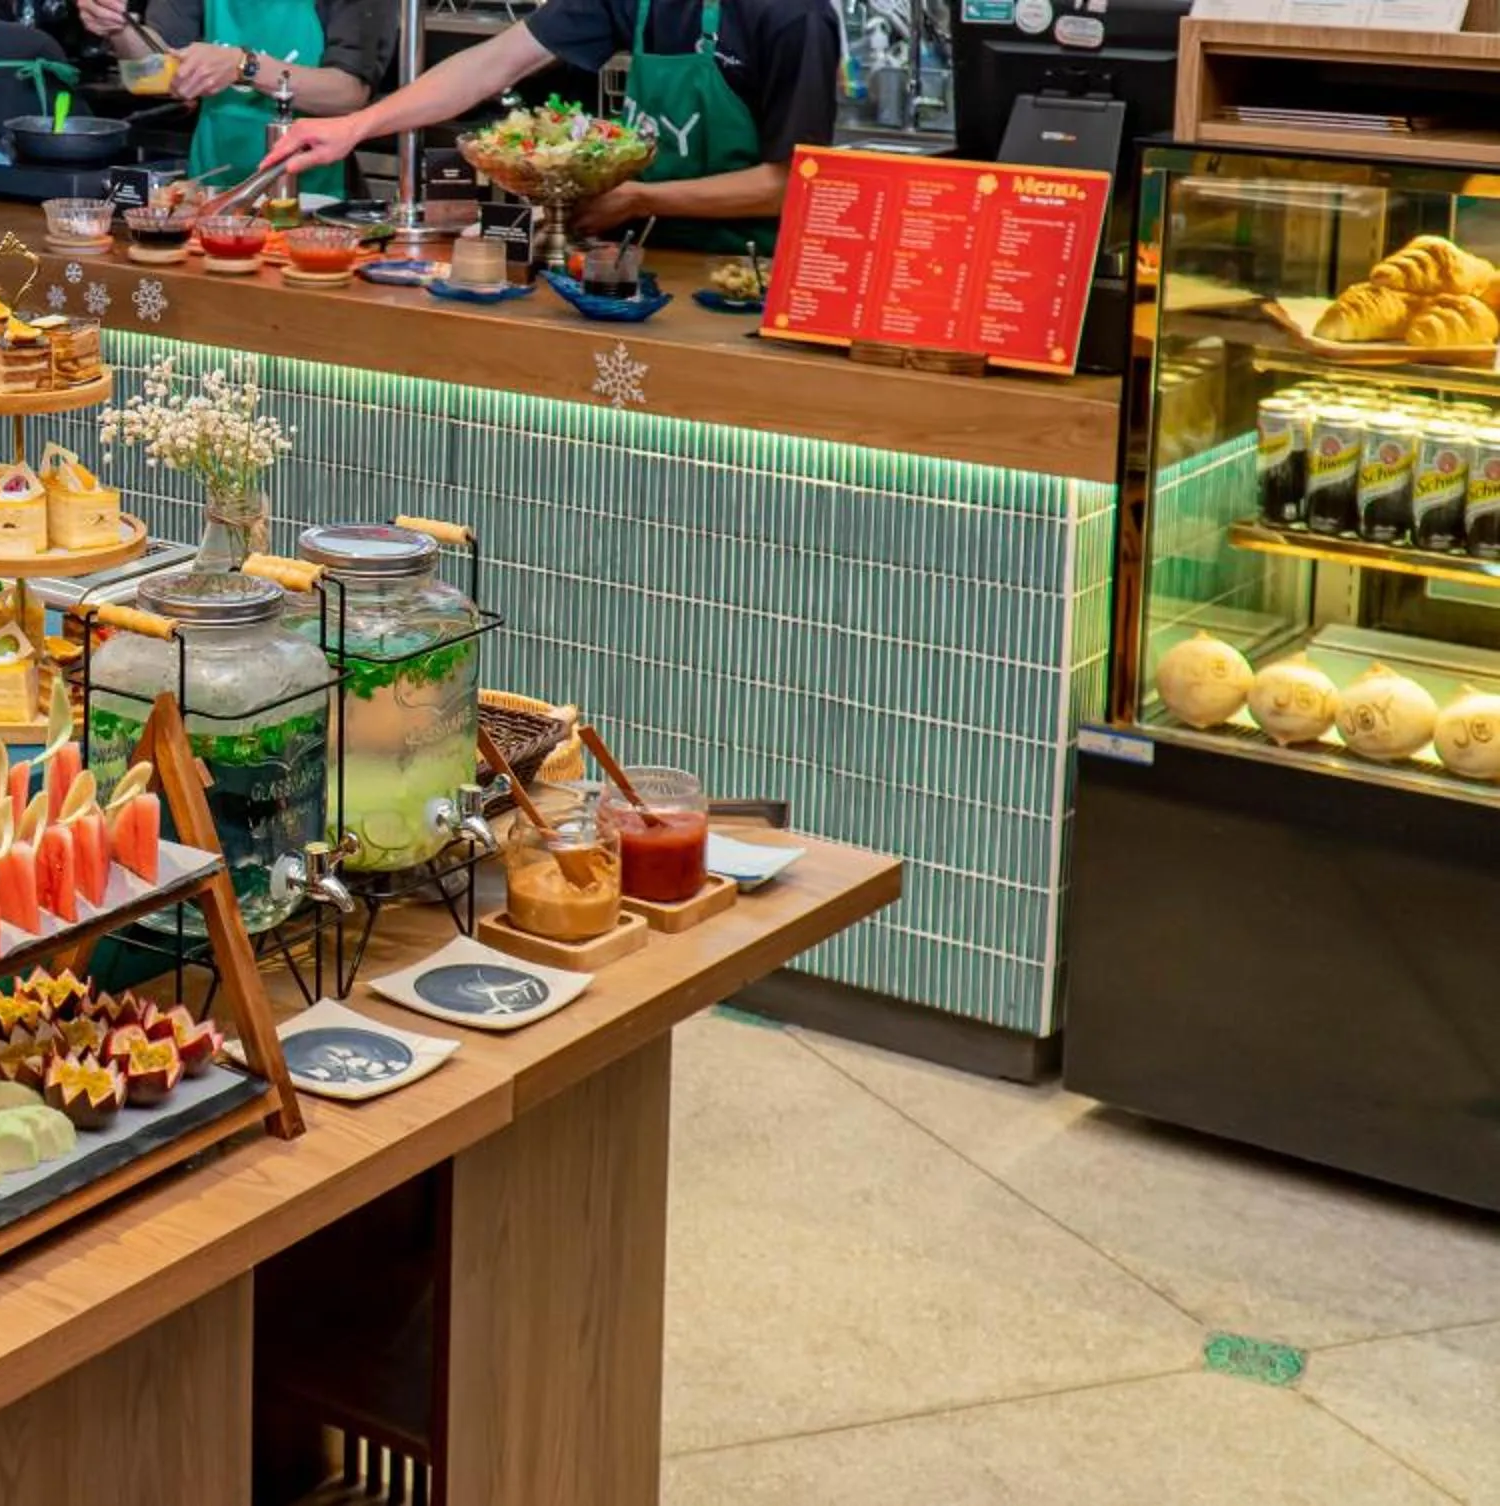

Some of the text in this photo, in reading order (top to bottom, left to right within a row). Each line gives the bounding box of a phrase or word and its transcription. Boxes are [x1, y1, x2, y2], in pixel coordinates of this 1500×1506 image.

[1012, 175, 1079, 198] Menu
[1344, 694, 1395, 736] JOY
[1453, 718, 1494, 749] JO
